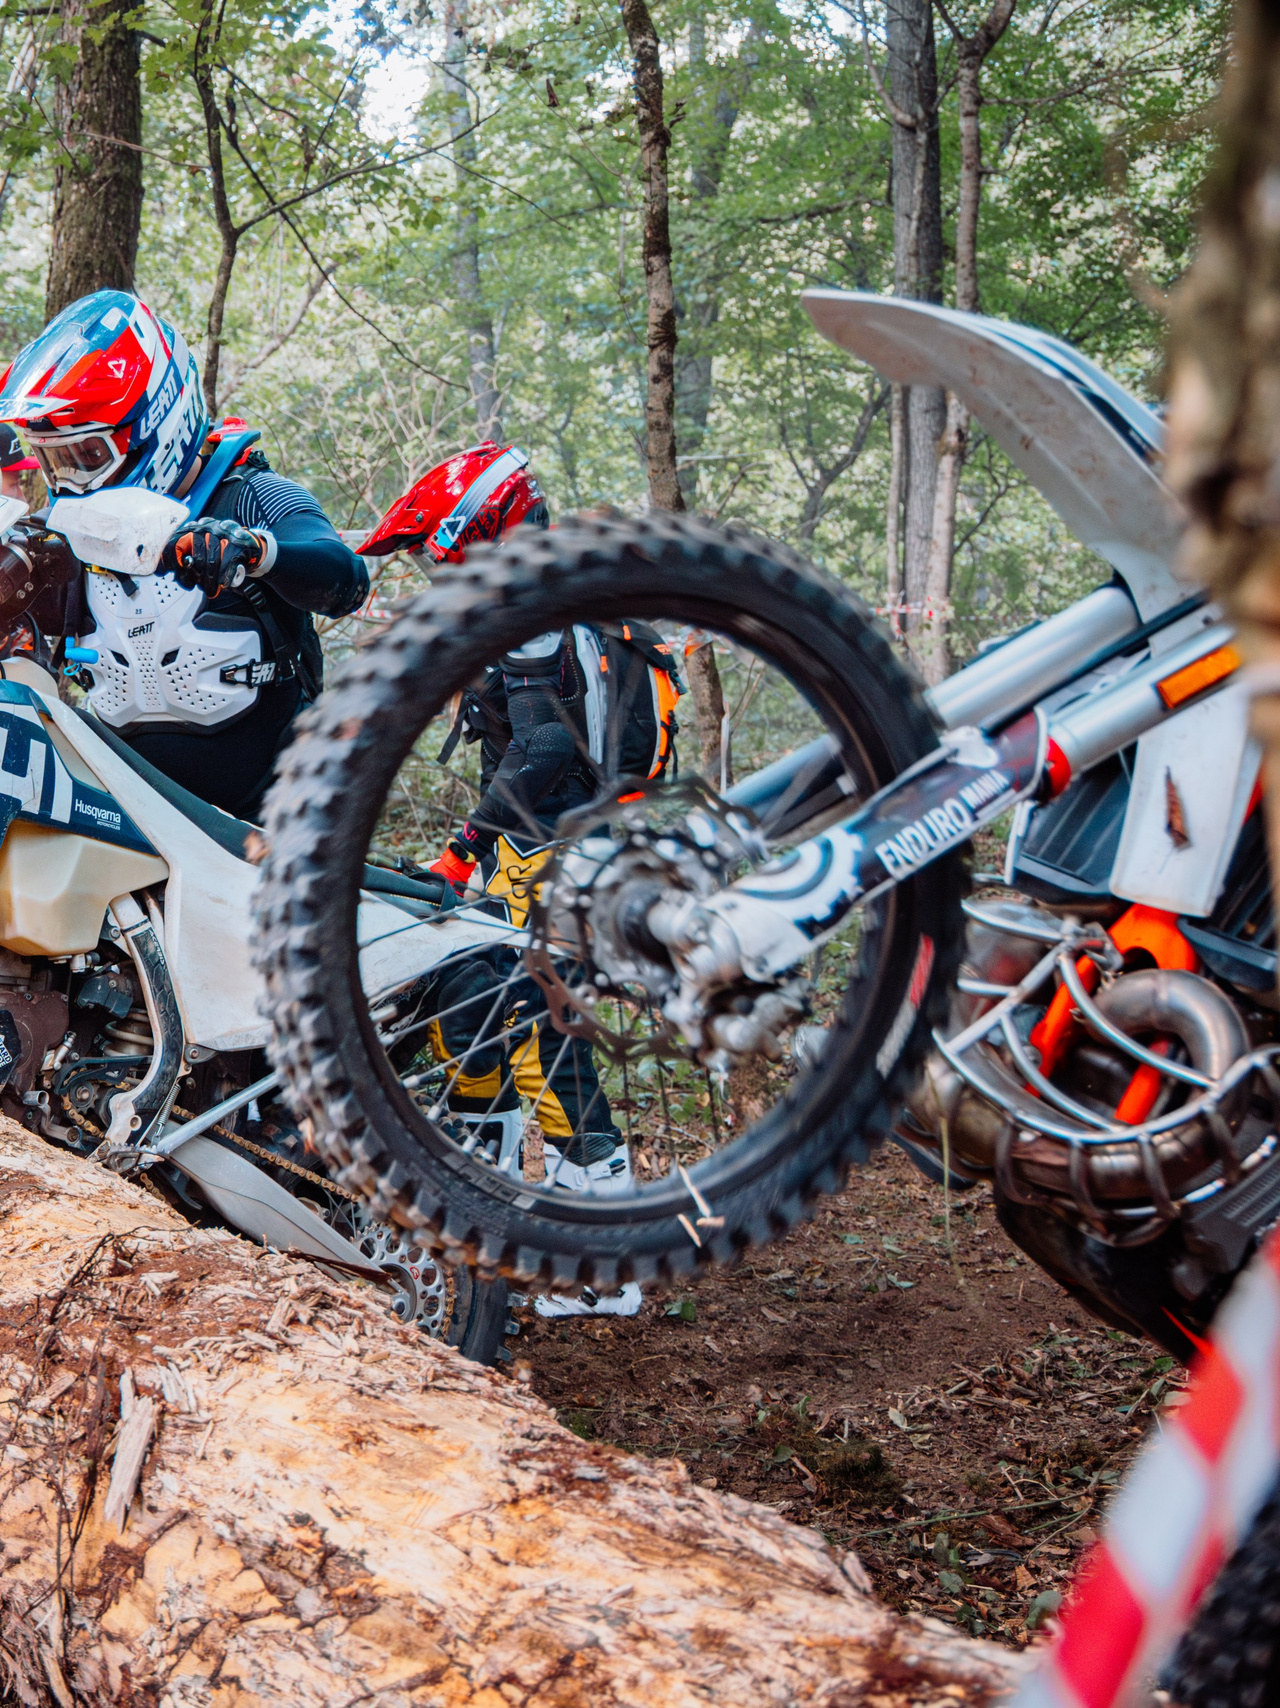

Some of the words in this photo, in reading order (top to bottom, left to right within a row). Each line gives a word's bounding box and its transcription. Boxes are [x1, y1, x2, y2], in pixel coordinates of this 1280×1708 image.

[139, 365, 178, 440] LEATT
[127, 621, 155, 639] LEATT
[74, 798, 121, 824] Husqvarna
[874, 797, 971, 877] ENDURO
[958, 769, 1010, 810] MANIA
